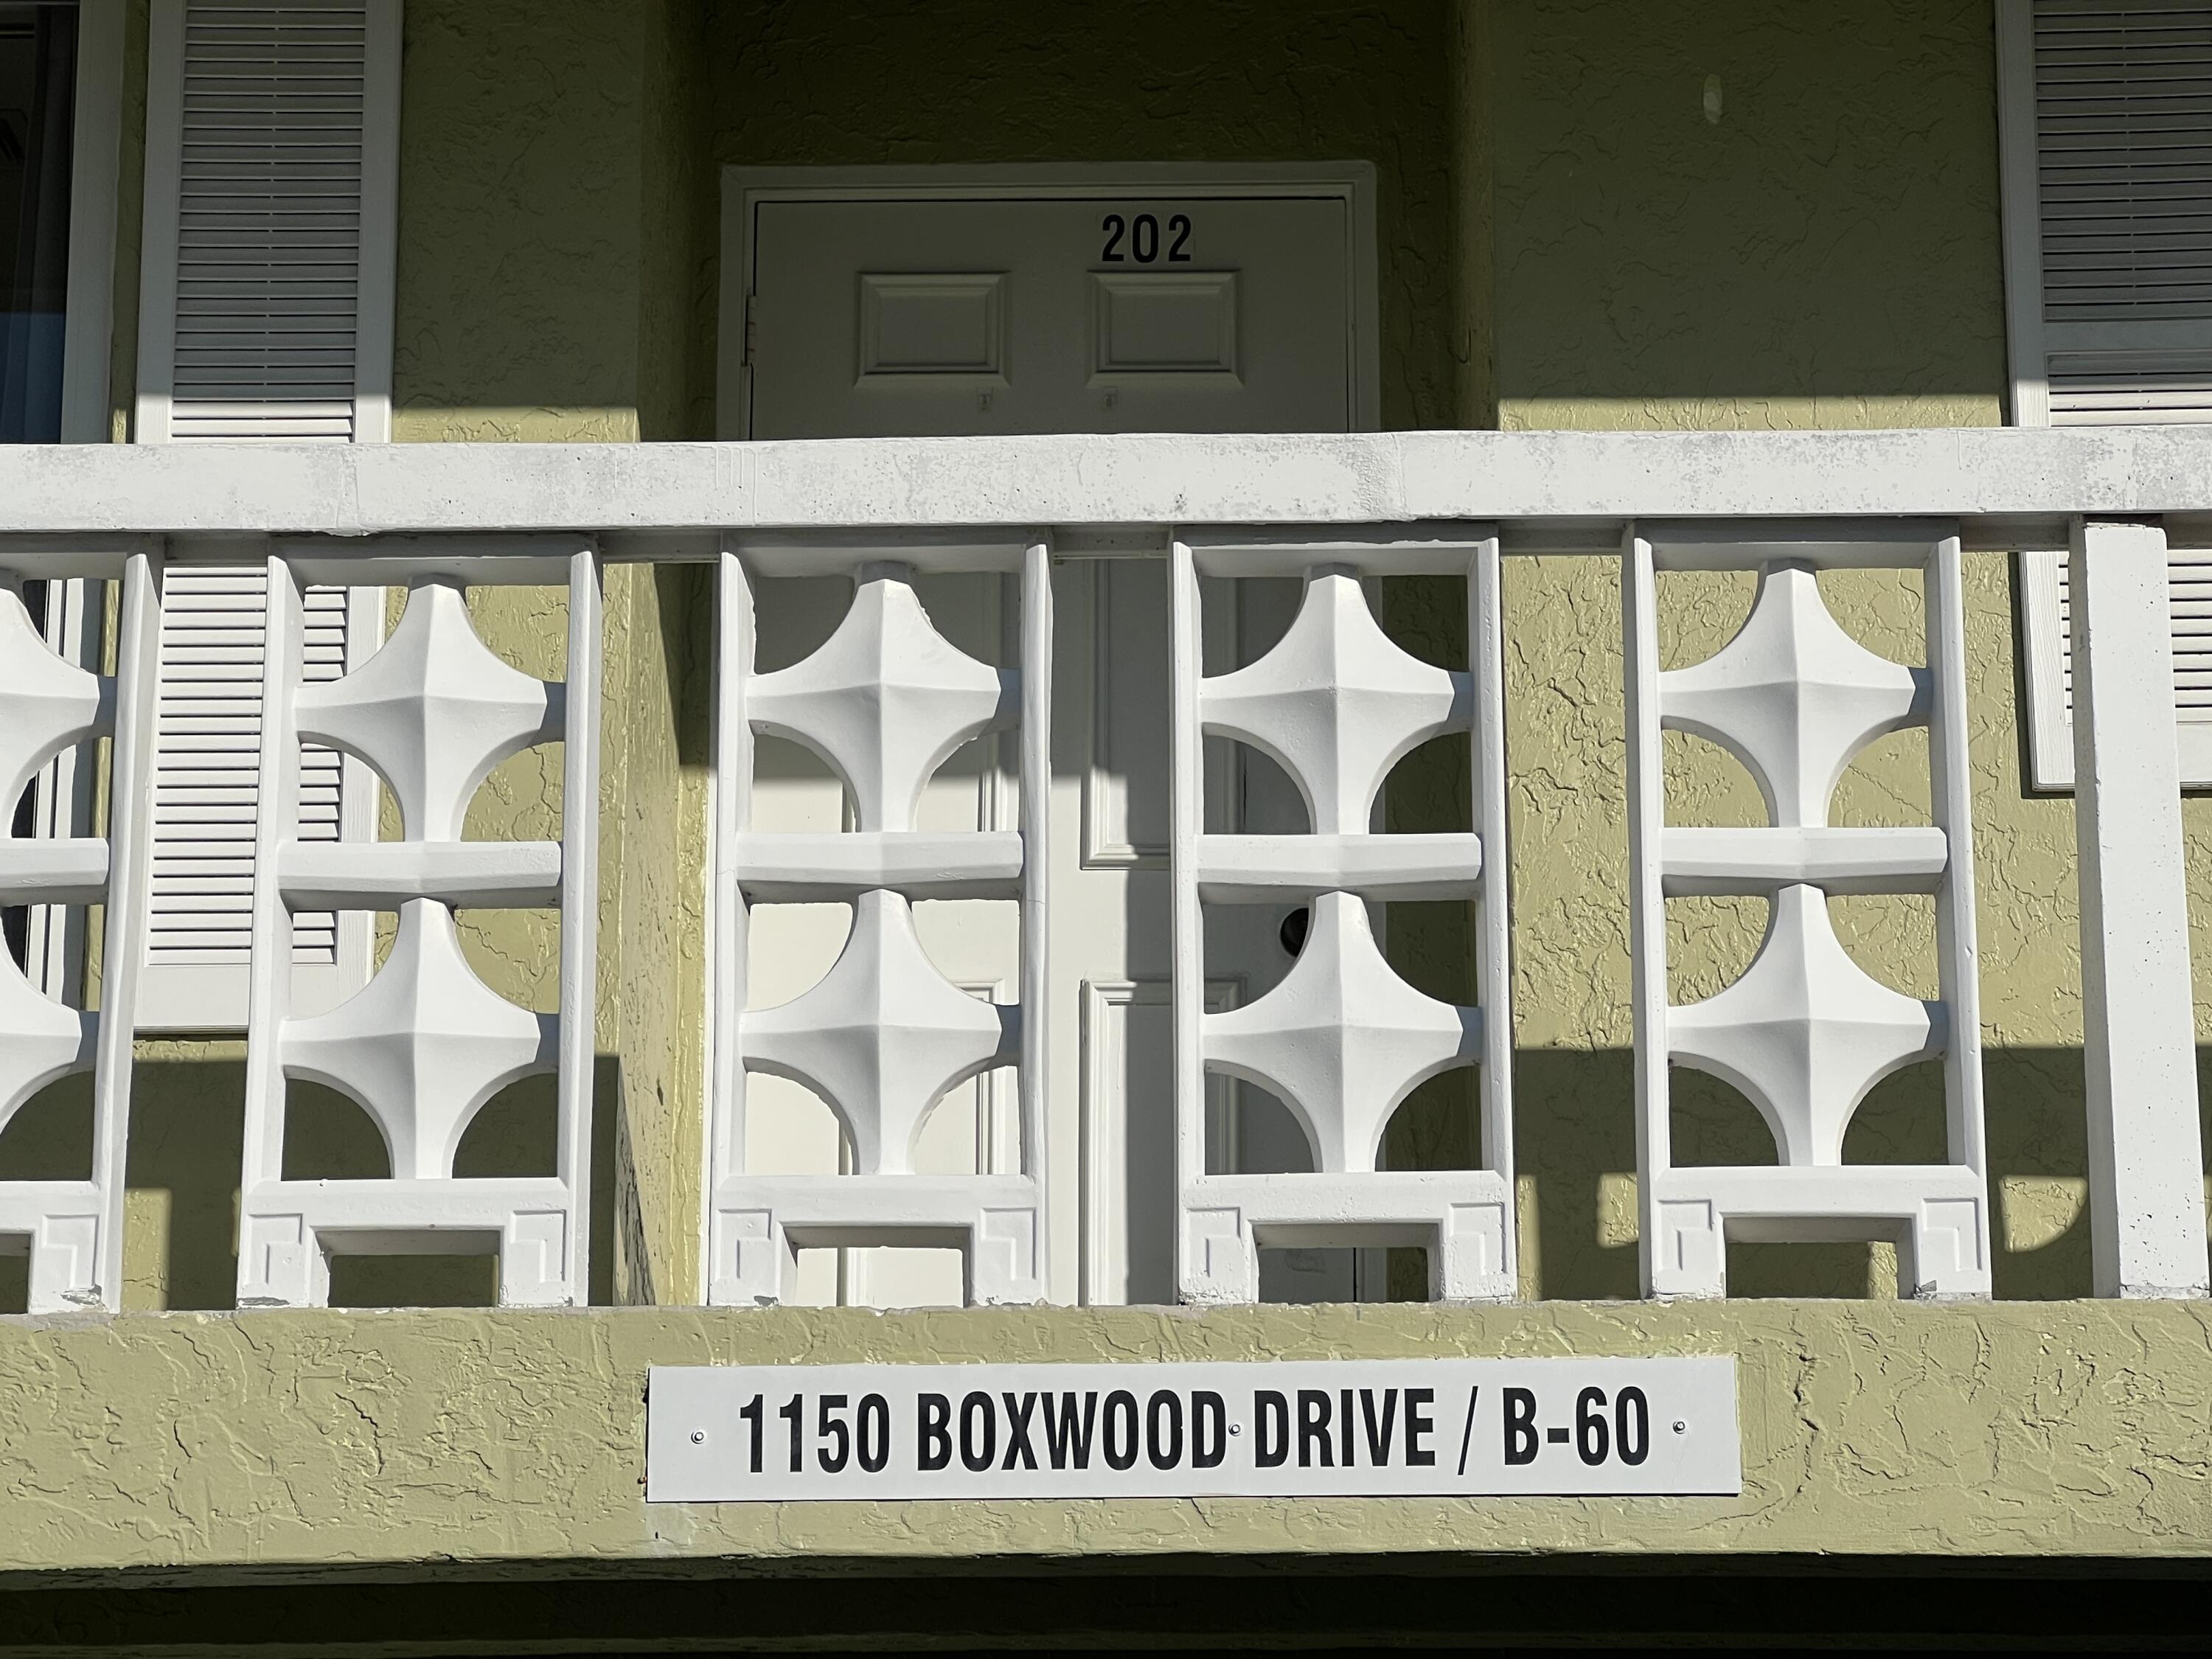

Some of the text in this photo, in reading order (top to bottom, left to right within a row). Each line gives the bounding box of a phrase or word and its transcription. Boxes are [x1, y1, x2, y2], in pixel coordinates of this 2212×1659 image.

[1102, 214, 1192, 263] 202
[739, 1385, 1650, 1475] 1150 BOXWOOD DRIVE / B-60
